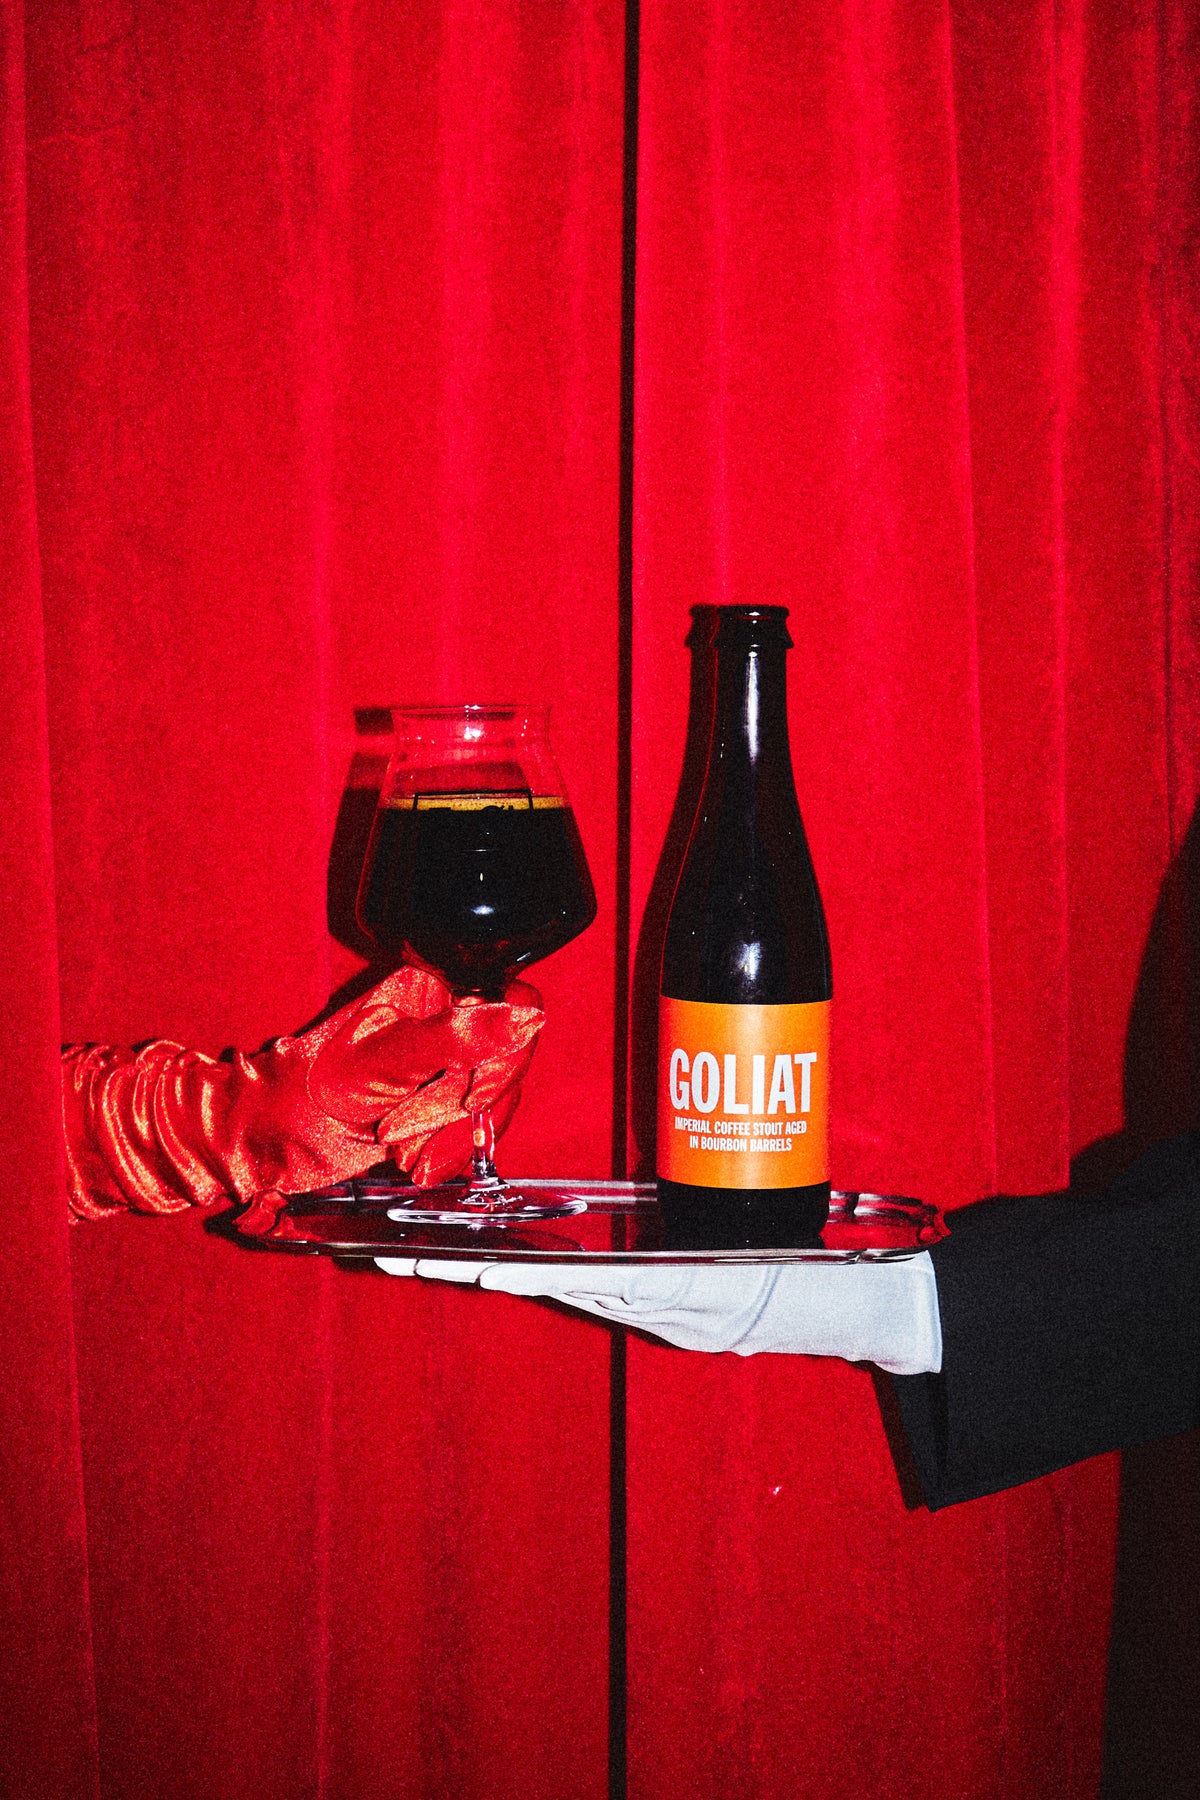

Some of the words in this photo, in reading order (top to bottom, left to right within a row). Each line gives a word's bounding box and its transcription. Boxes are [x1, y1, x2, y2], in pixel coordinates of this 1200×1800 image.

[669, 1048, 817, 1115] GOLIAT
[674, 1116, 711, 1134] IMPERIAL
[714, 1121, 750, 1136] COFFEE
[753, 1121, 783, 1136] STOUT
[785, 1120, 807, 1135] AGED
[689, 1135, 699, 1149] IN
[701, 1137, 747, 1152] BOURBON
[750, 1138, 793, 1152] BARRELS
